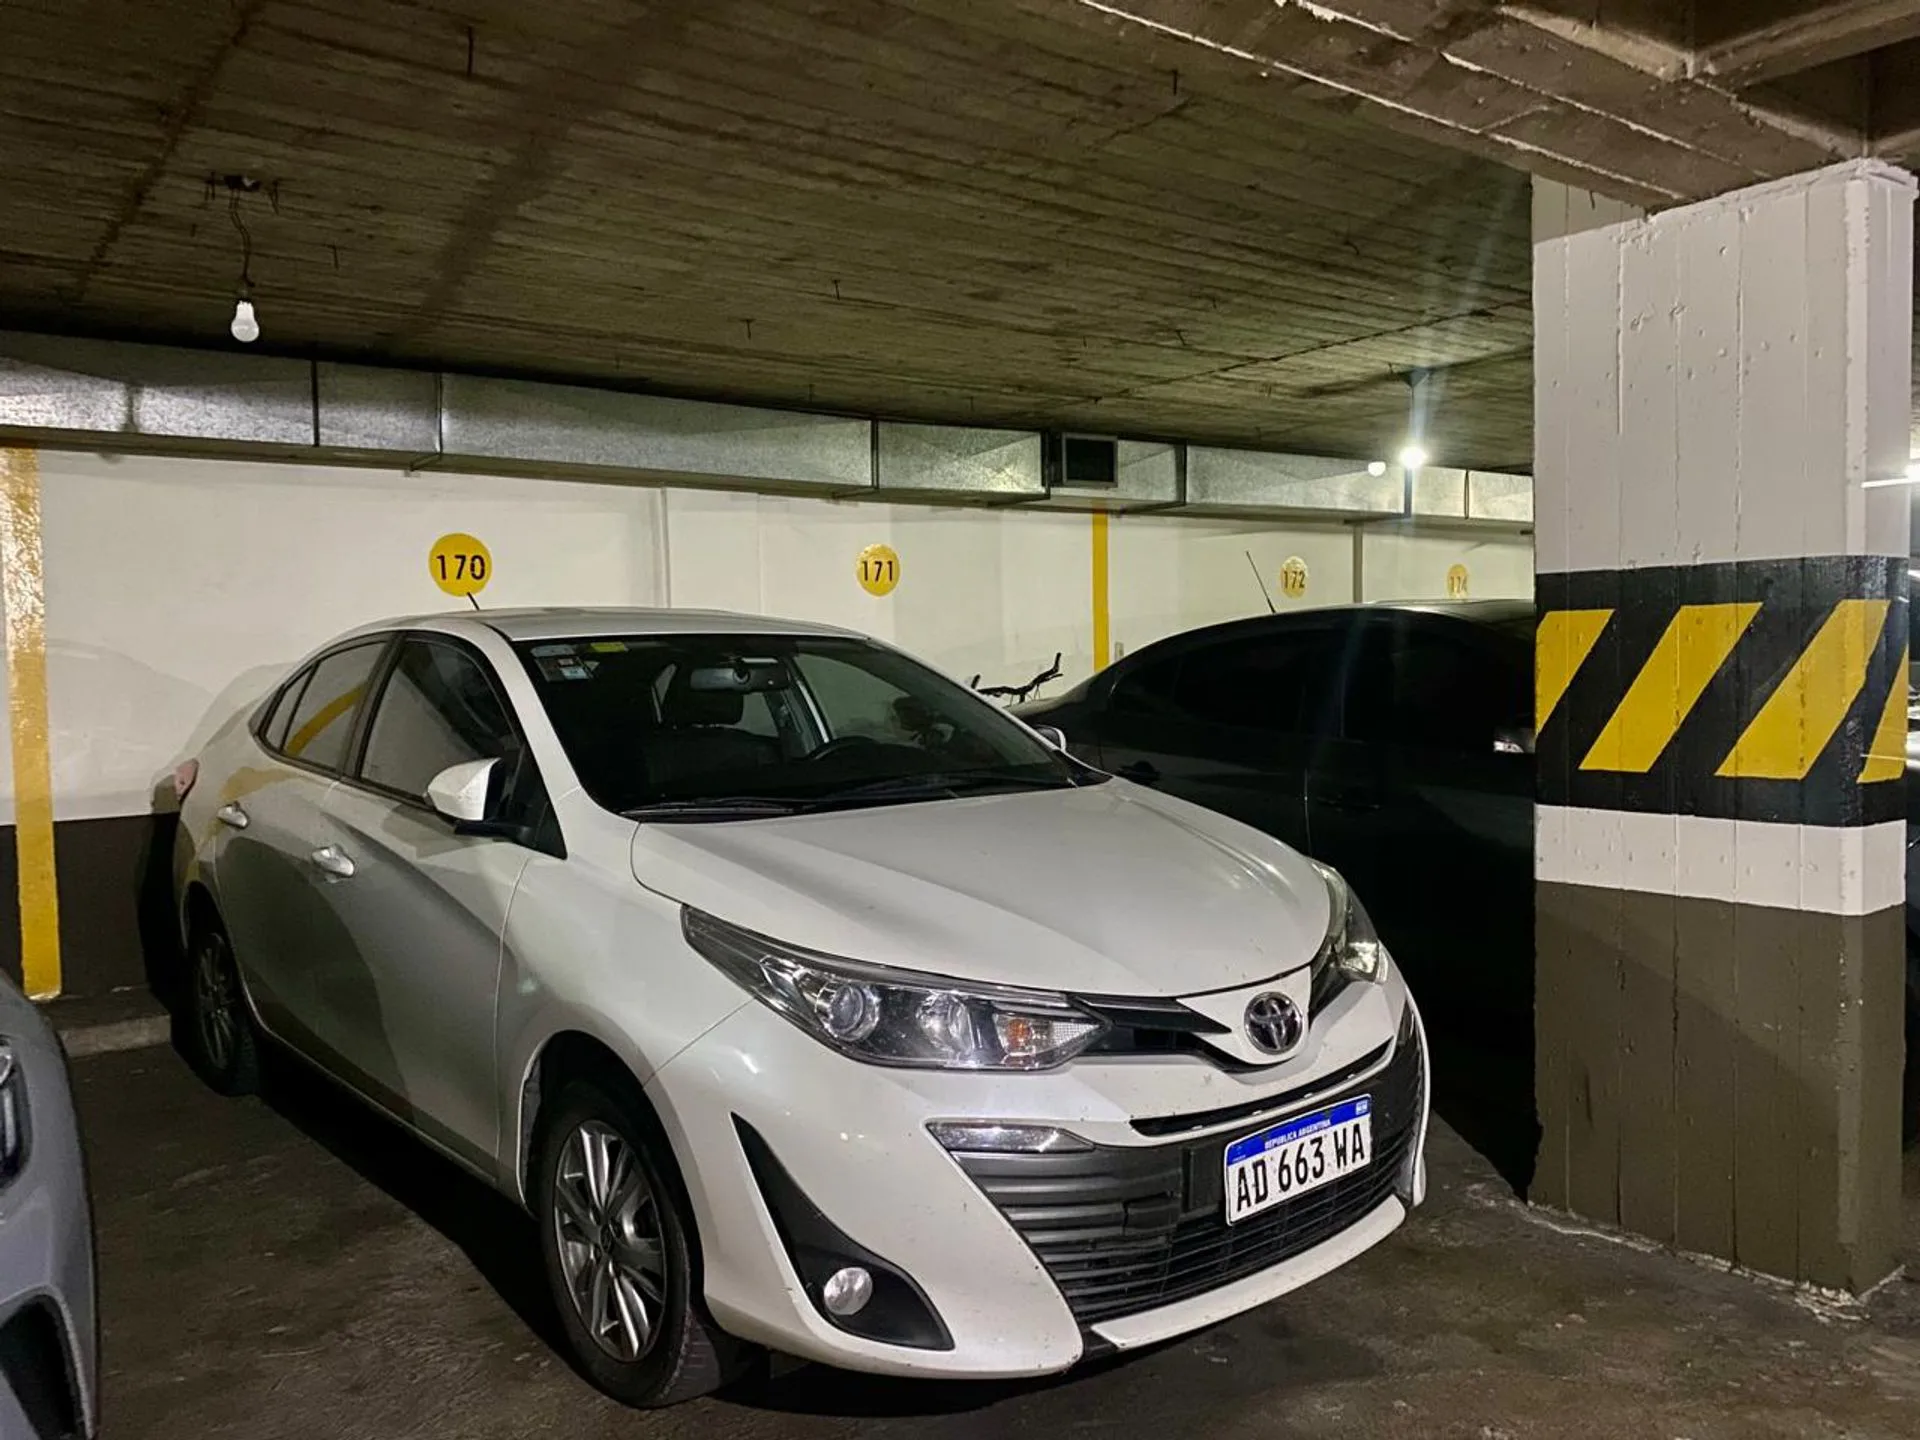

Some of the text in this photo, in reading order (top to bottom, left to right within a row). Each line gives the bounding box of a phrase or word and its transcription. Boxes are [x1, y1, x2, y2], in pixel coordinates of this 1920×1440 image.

[436, 554, 485, 580] 170
[861, 560, 893, 581] 171
[1283, 570, 1305, 588] 172
[1237, 1123, 1365, 1212] AD 663 WA
